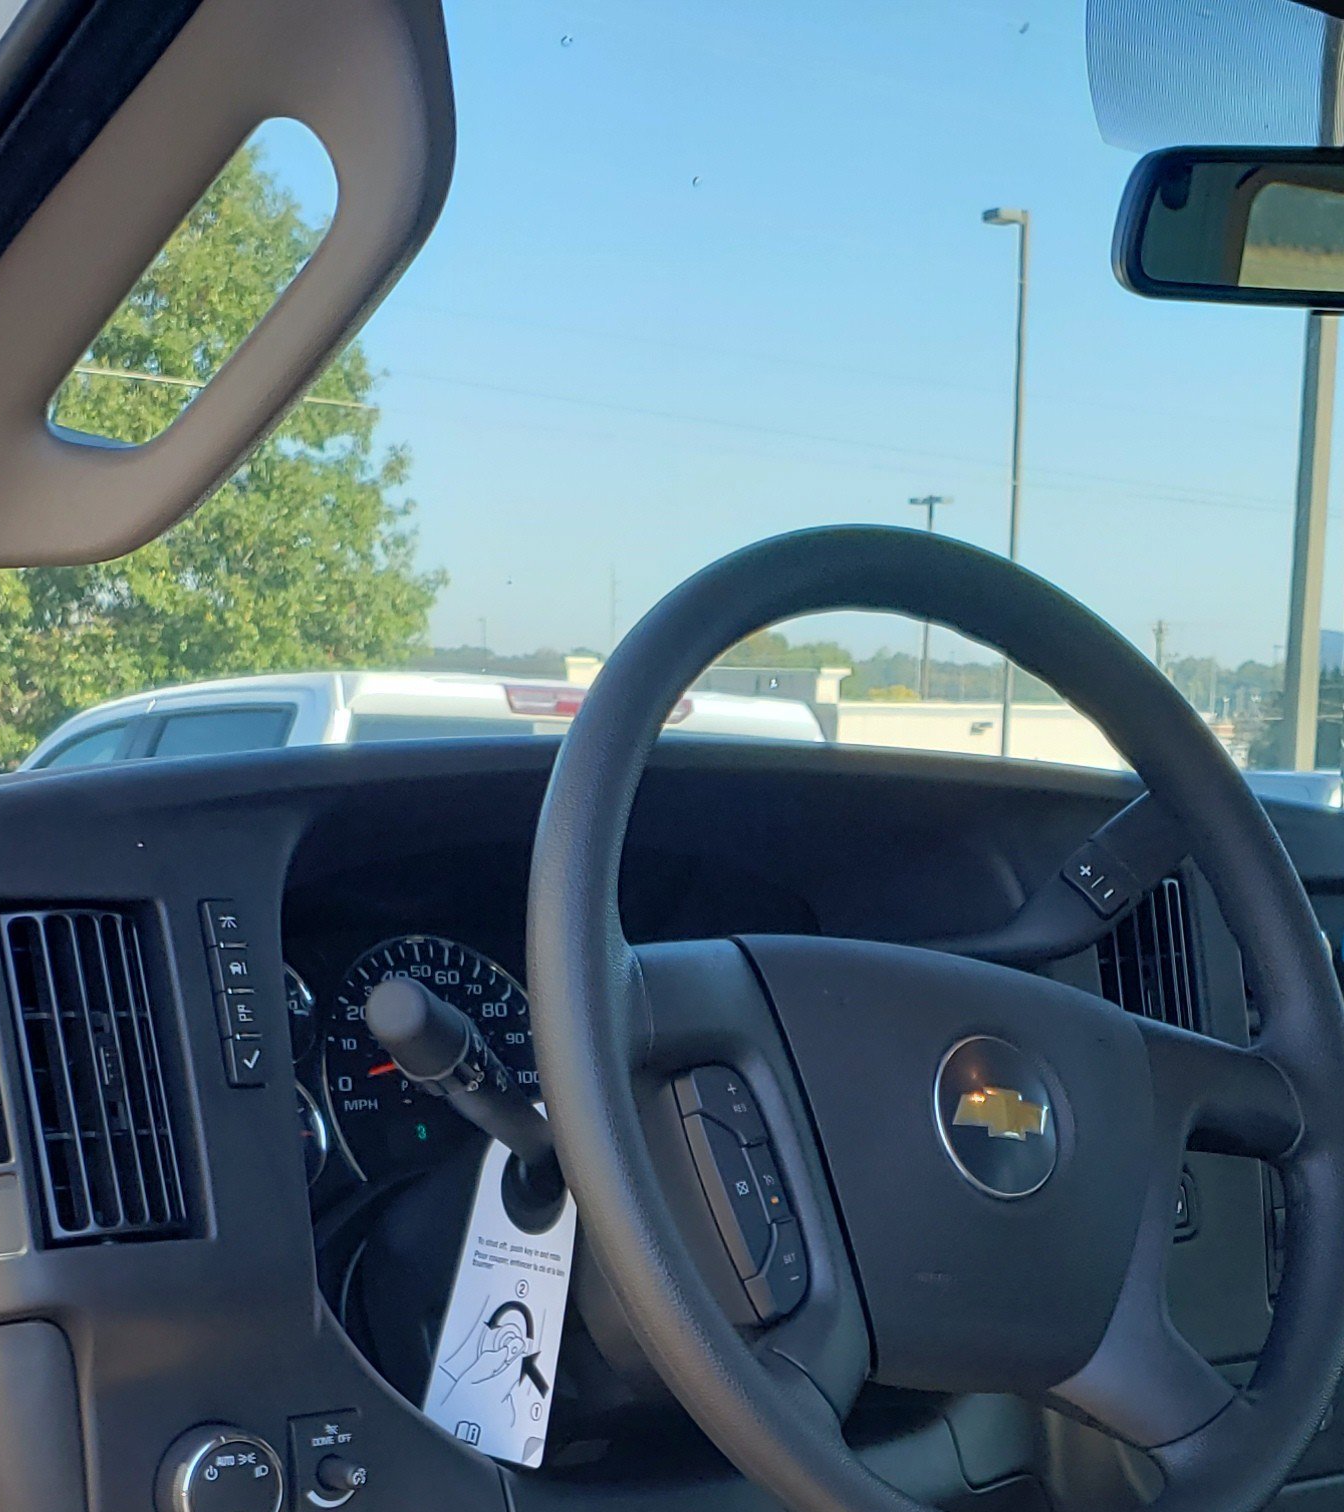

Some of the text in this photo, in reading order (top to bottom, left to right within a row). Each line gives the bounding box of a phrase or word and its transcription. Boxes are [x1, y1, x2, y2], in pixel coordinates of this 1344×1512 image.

[410, 964, 432, 978] 50
[434, 970, 460, 985] 60
[464, 984, 483, 996] 70
[482, 1002, 507, 1018] 80
[341, 1038, 357, 1051] 10
[505, 1032, 525, 1045] 90
[337, 1076, 353, 1092] 0
[344, 1099, 379, 1112] MPH
[311, 1433, 353, 1447] DOME OFF
